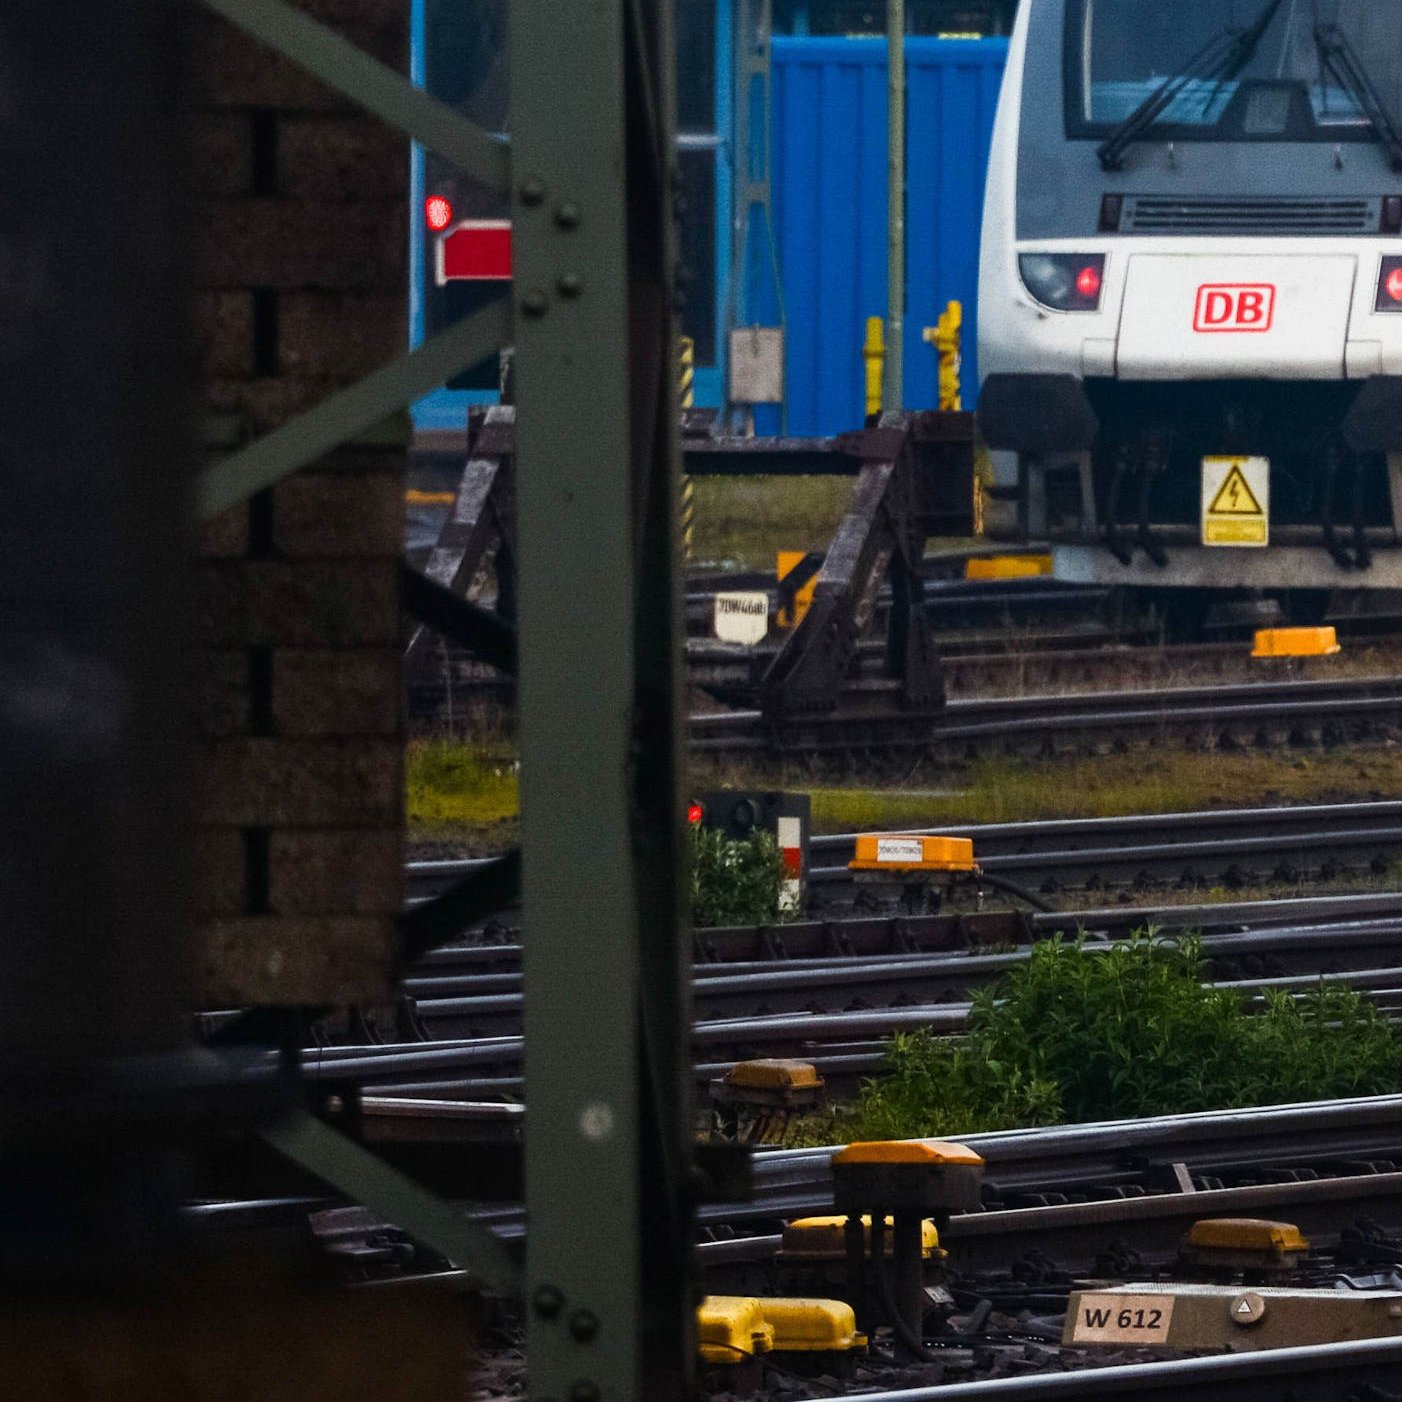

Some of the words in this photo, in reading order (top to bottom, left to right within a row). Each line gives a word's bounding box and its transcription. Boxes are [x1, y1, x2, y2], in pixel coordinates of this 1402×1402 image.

[1203, 291, 1264, 324] DB
[1085, 1308, 1112, 1328] W
[1117, 1309, 1163, 1329] 612
